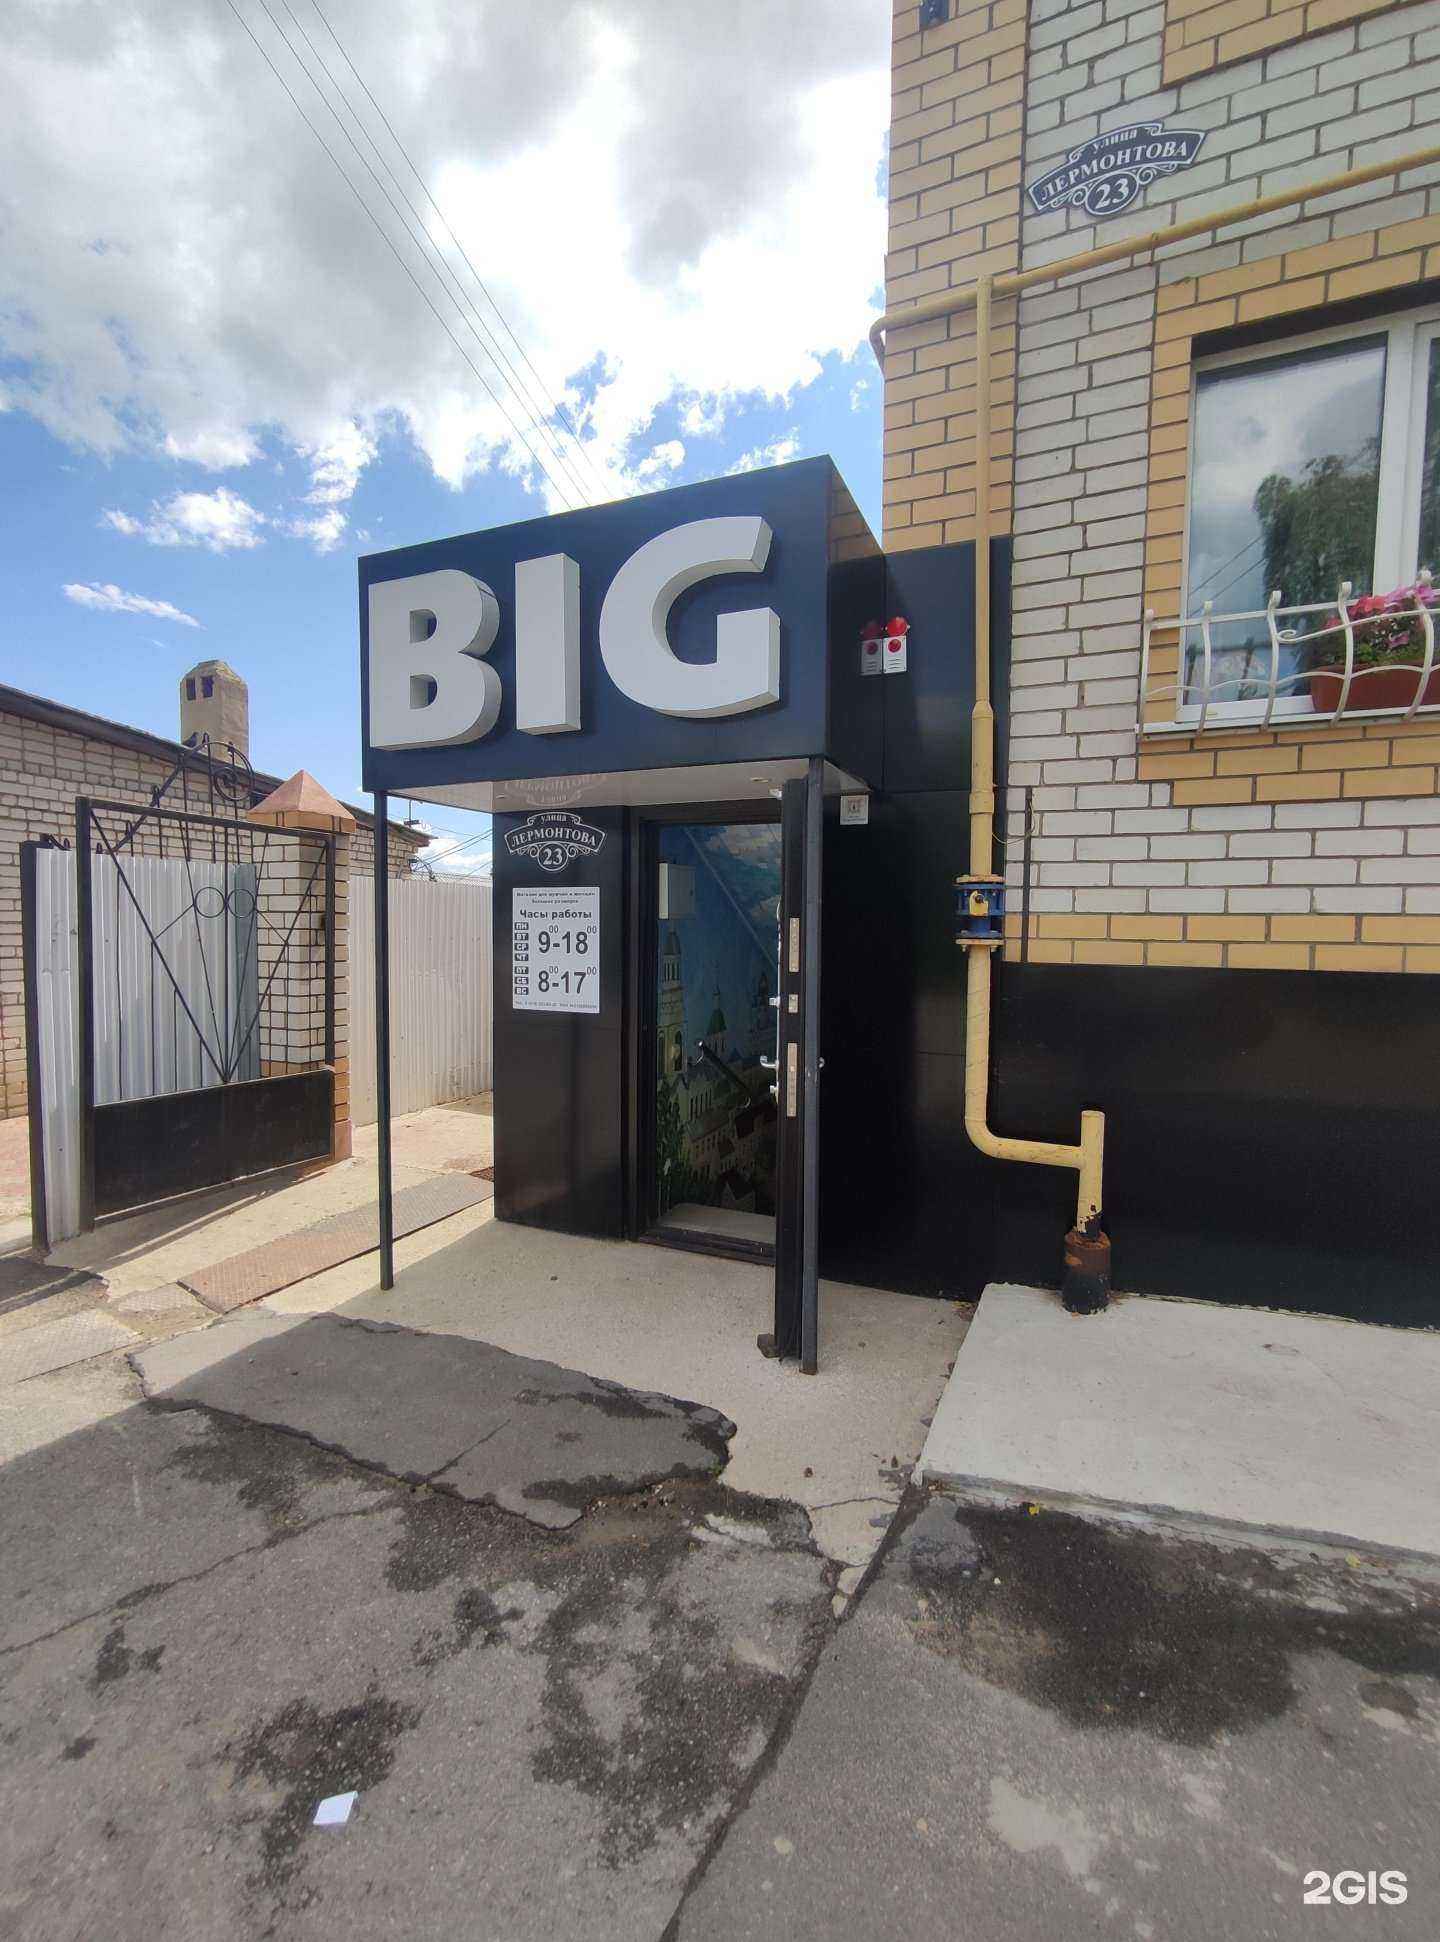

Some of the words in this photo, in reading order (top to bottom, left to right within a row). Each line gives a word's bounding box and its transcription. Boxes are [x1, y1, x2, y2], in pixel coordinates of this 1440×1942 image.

[1092, 129, 1138, 155] улица
[1041, 141, 1187, 200] ЛЕРМОНТОВА
[1095, 177, 1129, 209] 23
[368, 516, 781, 751] BIG
[541, 814, 567, 824] улица
[511, 827, 596, 847] ЛЕРМОНТОВА
[543, 848, 563, 865] 23
[520, 909, 548, 919] Часы
[552, 909, 592, 920] работы
